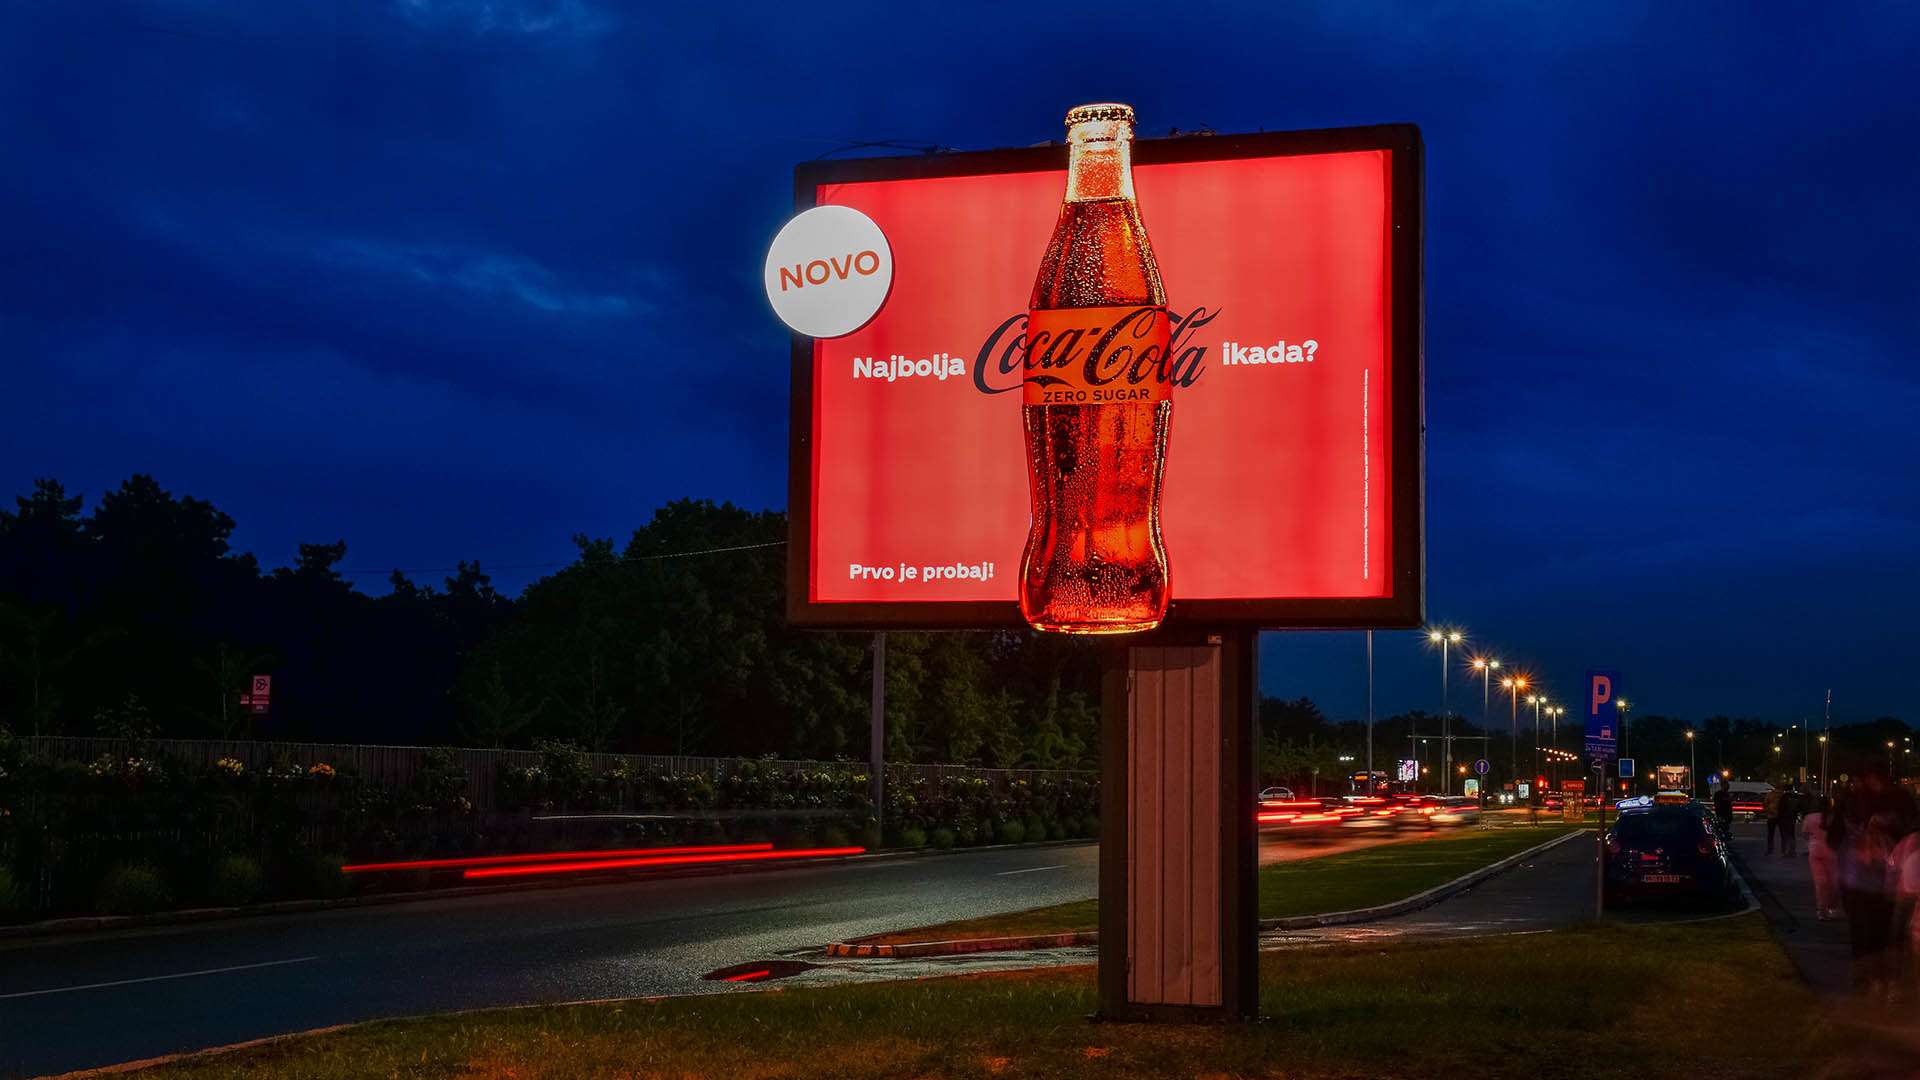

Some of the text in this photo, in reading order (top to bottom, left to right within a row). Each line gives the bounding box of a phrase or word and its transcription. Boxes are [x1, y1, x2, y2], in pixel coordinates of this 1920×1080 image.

[779, 250, 880, 291] NOVO
[853, 306, 1319, 395] Najbolja Coca-Cola ikada?
[1043, 388, 1150, 403] ZERO SUGAR
[850, 561, 994, 583] Prvo je probaj!
[1591, 675, 1611, 715] P
